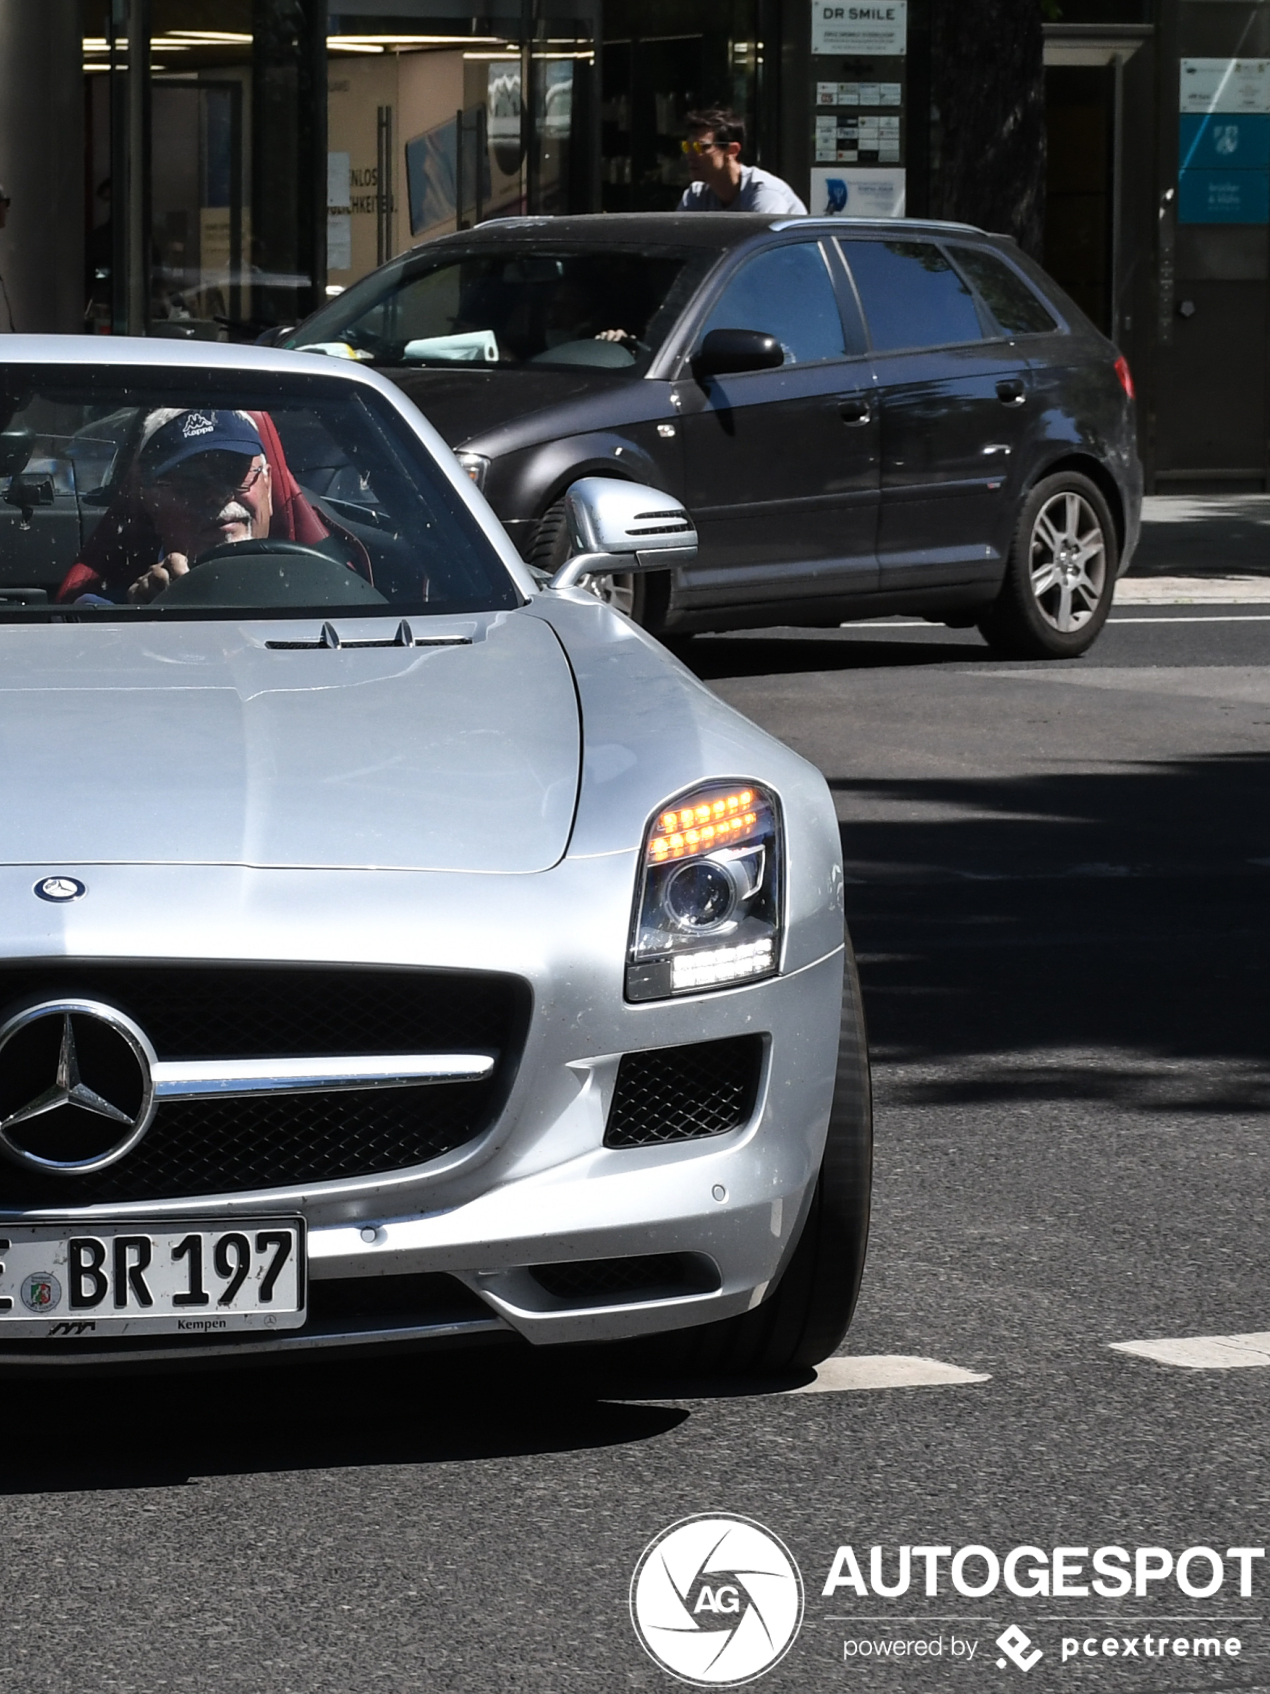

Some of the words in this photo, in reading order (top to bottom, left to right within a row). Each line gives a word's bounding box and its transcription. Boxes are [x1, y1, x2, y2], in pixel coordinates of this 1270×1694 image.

[823, 7, 844, 19] DR
[849, 8, 895, 20] SMILE
[183, 425, 214, 438] Kappa
[69, 1235, 153, 1309] BR
[173, 1230, 292, 1306] 197
[177, 1318, 227, 1332] Kempen
